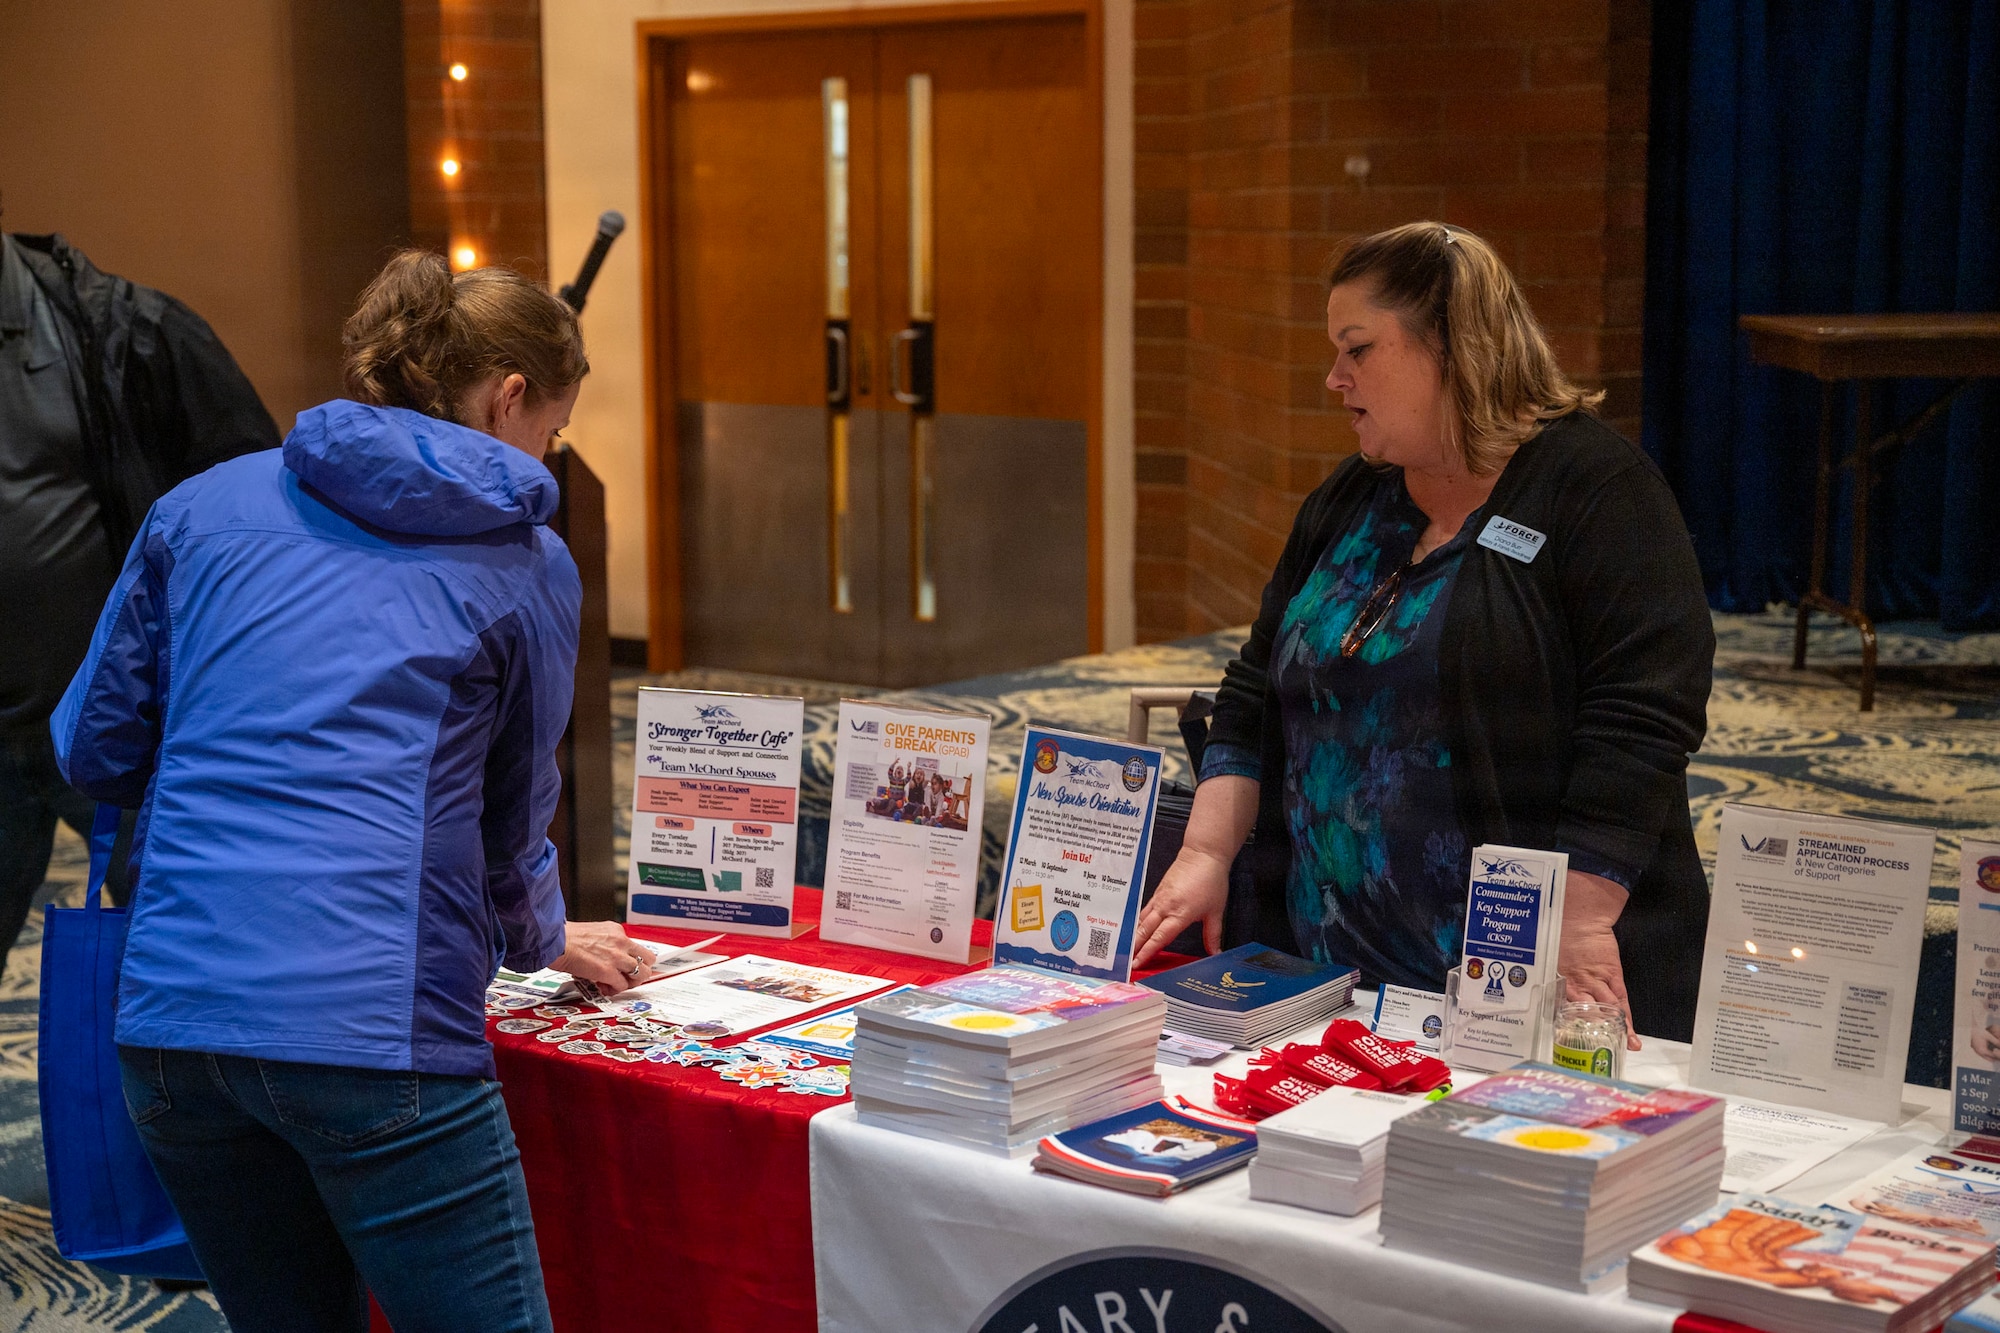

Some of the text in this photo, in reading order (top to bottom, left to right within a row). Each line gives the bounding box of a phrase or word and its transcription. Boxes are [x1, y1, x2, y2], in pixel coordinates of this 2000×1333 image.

[648, 722, 793, 748] "Stronger Together Cafe"
[885, 722, 915, 737] GIVE
[918, 726, 976, 745] PARENTS
[666, 745, 687, 754] Weekly
[717, 750, 740, 758] Support
[756, 752, 788, 760] Connection
[884, 738, 970, 759] a BREAK (GPAB)
[659, 761, 776, 779] Team McChord Spouses
[680, 781, 750, 794] What You Can Expect
[1070, 777, 1110, 790] Team McChord
[1054, 786, 1089, 808] Spouse
[1090, 792, 1141, 818] Orientation
[664, 819, 683, 828] When
[742, 825, 764, 834] Where
[843, 820, 864, 828] Eligibility
[652, 832, 666, 840] Every
[841, 848, 881, 859] Program Benefits
[1798, 839, 1866, 854] STREAMLINED
[1062, 850, 1092, 864] Join Us!
[1797, 848, 1860, 864] APPLICATION
[1863, 857, 1910, 871] PROCESS
[1024, 858, 1036, 866] March
[1047, 862, 1068, 873] September
[1795, 858, 1802, 866] &
[1805, 859, 1825, 869] New
[1827, 862, 1876, 877] Categories
[1086, 872, 1096, 880] June
[1107, 876, 1127, 886] December
[1806, 869, 1840, 881] Support
[1486, 876, 1542, 890] Team McChord
[1055, 887, 1064, 896] Bldg
[1475, 885, 1534, 903] Commander's
[876, 896, 901, 905] Information
[1053, 896, 1080, 908] McChord Field
[1476, 901, 1530, 918] Key Support
[1086, 915, 1118, 927] Sign Up Here
[1482, 917, 1521, 932] Program
[1487, 932, 1513, 945] (CKSP)
[1033, 958, 1048, 966] Contact
[977, 974, 1034, 992] Were
[998, 969, 1104, 996] While You
[1972, 989, 1985, 997] few
[1989, 1003, 1998, 1011] up
[1459, 1008, 1524, 1025] Key Support Liaison's
[1353, 1039, 1392, 1068] SOURCE
[1361, 1036, 1401, 1065] ONE
[1314, 1056, 1358, 1079] ONE
[1321, 1053, 1362, 1074] MILITARY
[1562, 1056, 1587, 1066] PICKLE
[1306, 1059, 1349, 1082] SOURCE
[1522, 1068, 1657, 1104] While You
[1962, 1074, 1992, 1085] 4 Mar
[1502, 1077, 1577, 1100] Were
[1961, 1088, 1988, 1101] 2 Sep
[1961, 1115, 1983, 1130] Bldg
[1746, 1200, 1852, 1230] Daddy's
[1870, 1228, 1965, 1253] Boots
